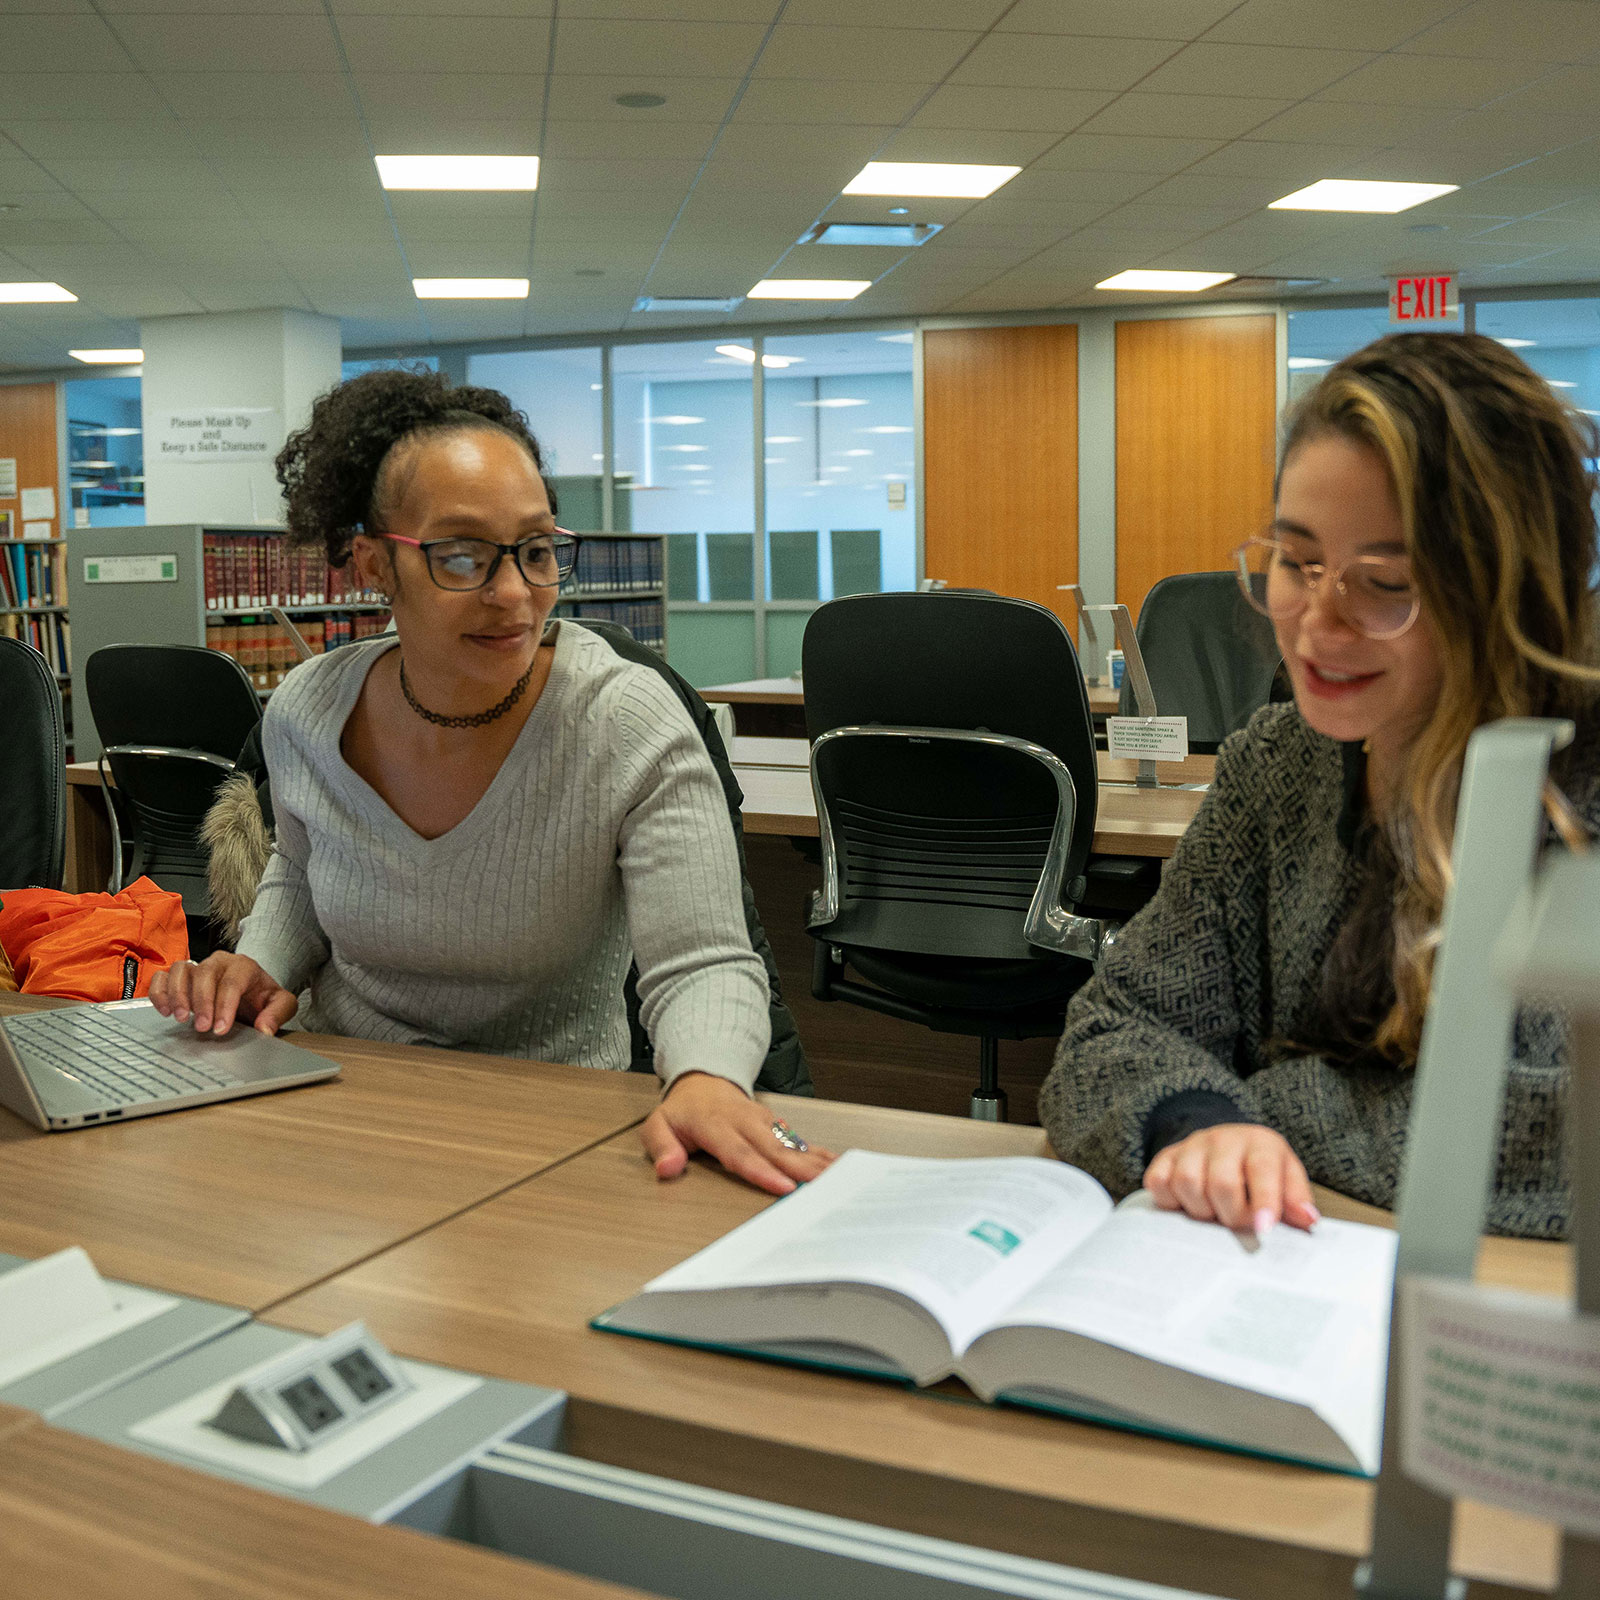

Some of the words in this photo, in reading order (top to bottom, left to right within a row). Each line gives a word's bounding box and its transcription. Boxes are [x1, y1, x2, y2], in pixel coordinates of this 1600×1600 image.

[1397, 277, 1451, 319] EXIT
[170, 416, 202, 428] Please
[205, 417, 233, 427] Mask
[235, 416, 251, 429] Up
[202, 430, 221, 439] and
[161, 442, 187, 454] Keep
[197, 442, 218, 451] Safe
[221, 442, 266, 451] Distance
